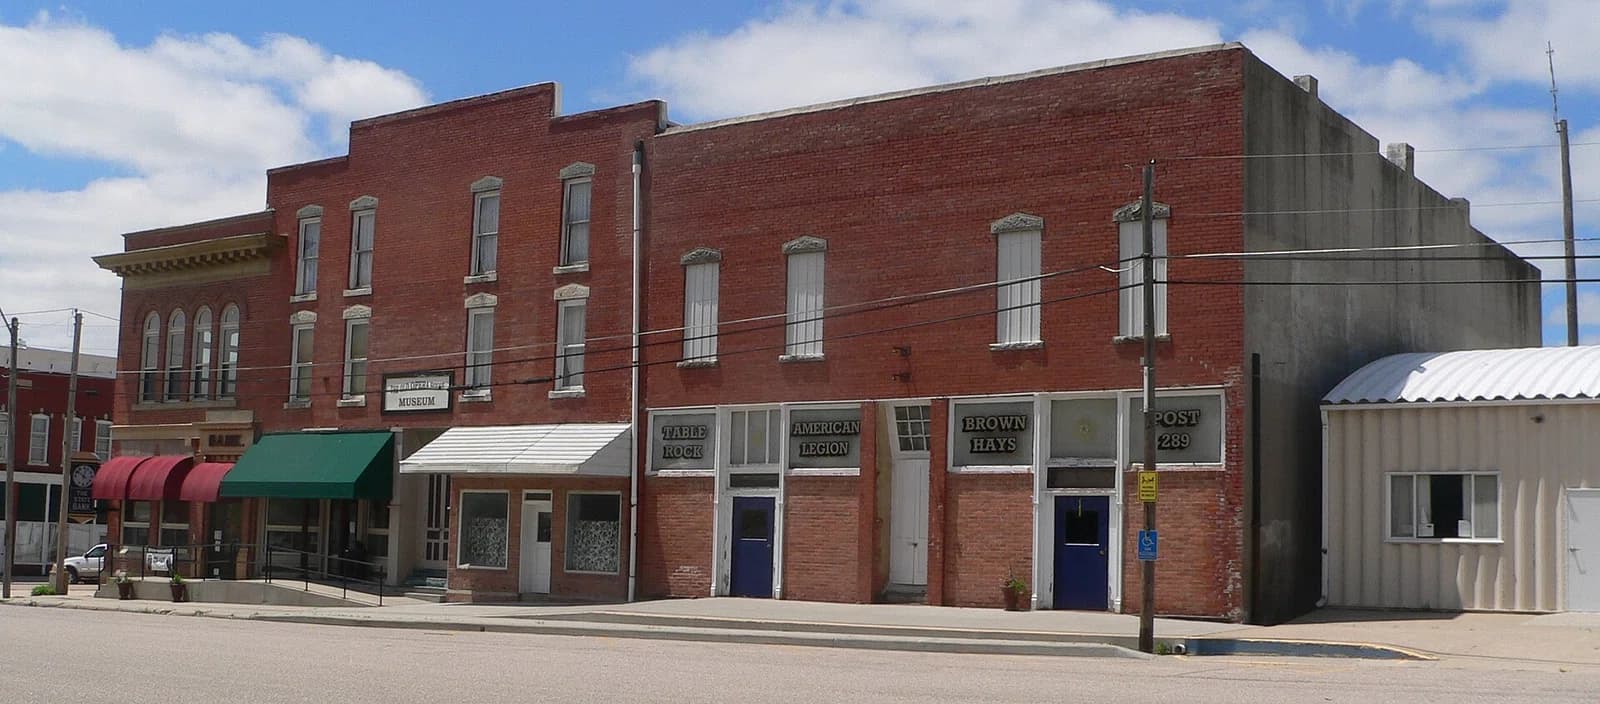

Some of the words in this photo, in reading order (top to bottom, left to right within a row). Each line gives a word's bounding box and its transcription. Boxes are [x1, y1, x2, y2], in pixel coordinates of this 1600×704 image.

[398, 396, 435, 407] MUSEUM
[962, 415, 1026, 432] BROWN
[1153, 409, 1200, 426] POST
[662, 425, 707, 440] TABLE
[792, 421, 862, 435] AMERICAN
[663, 445, 703, 459] ROCK
[800, 442, 849, 457] LEGION
[970, 437, 1017, 453] HAYS
